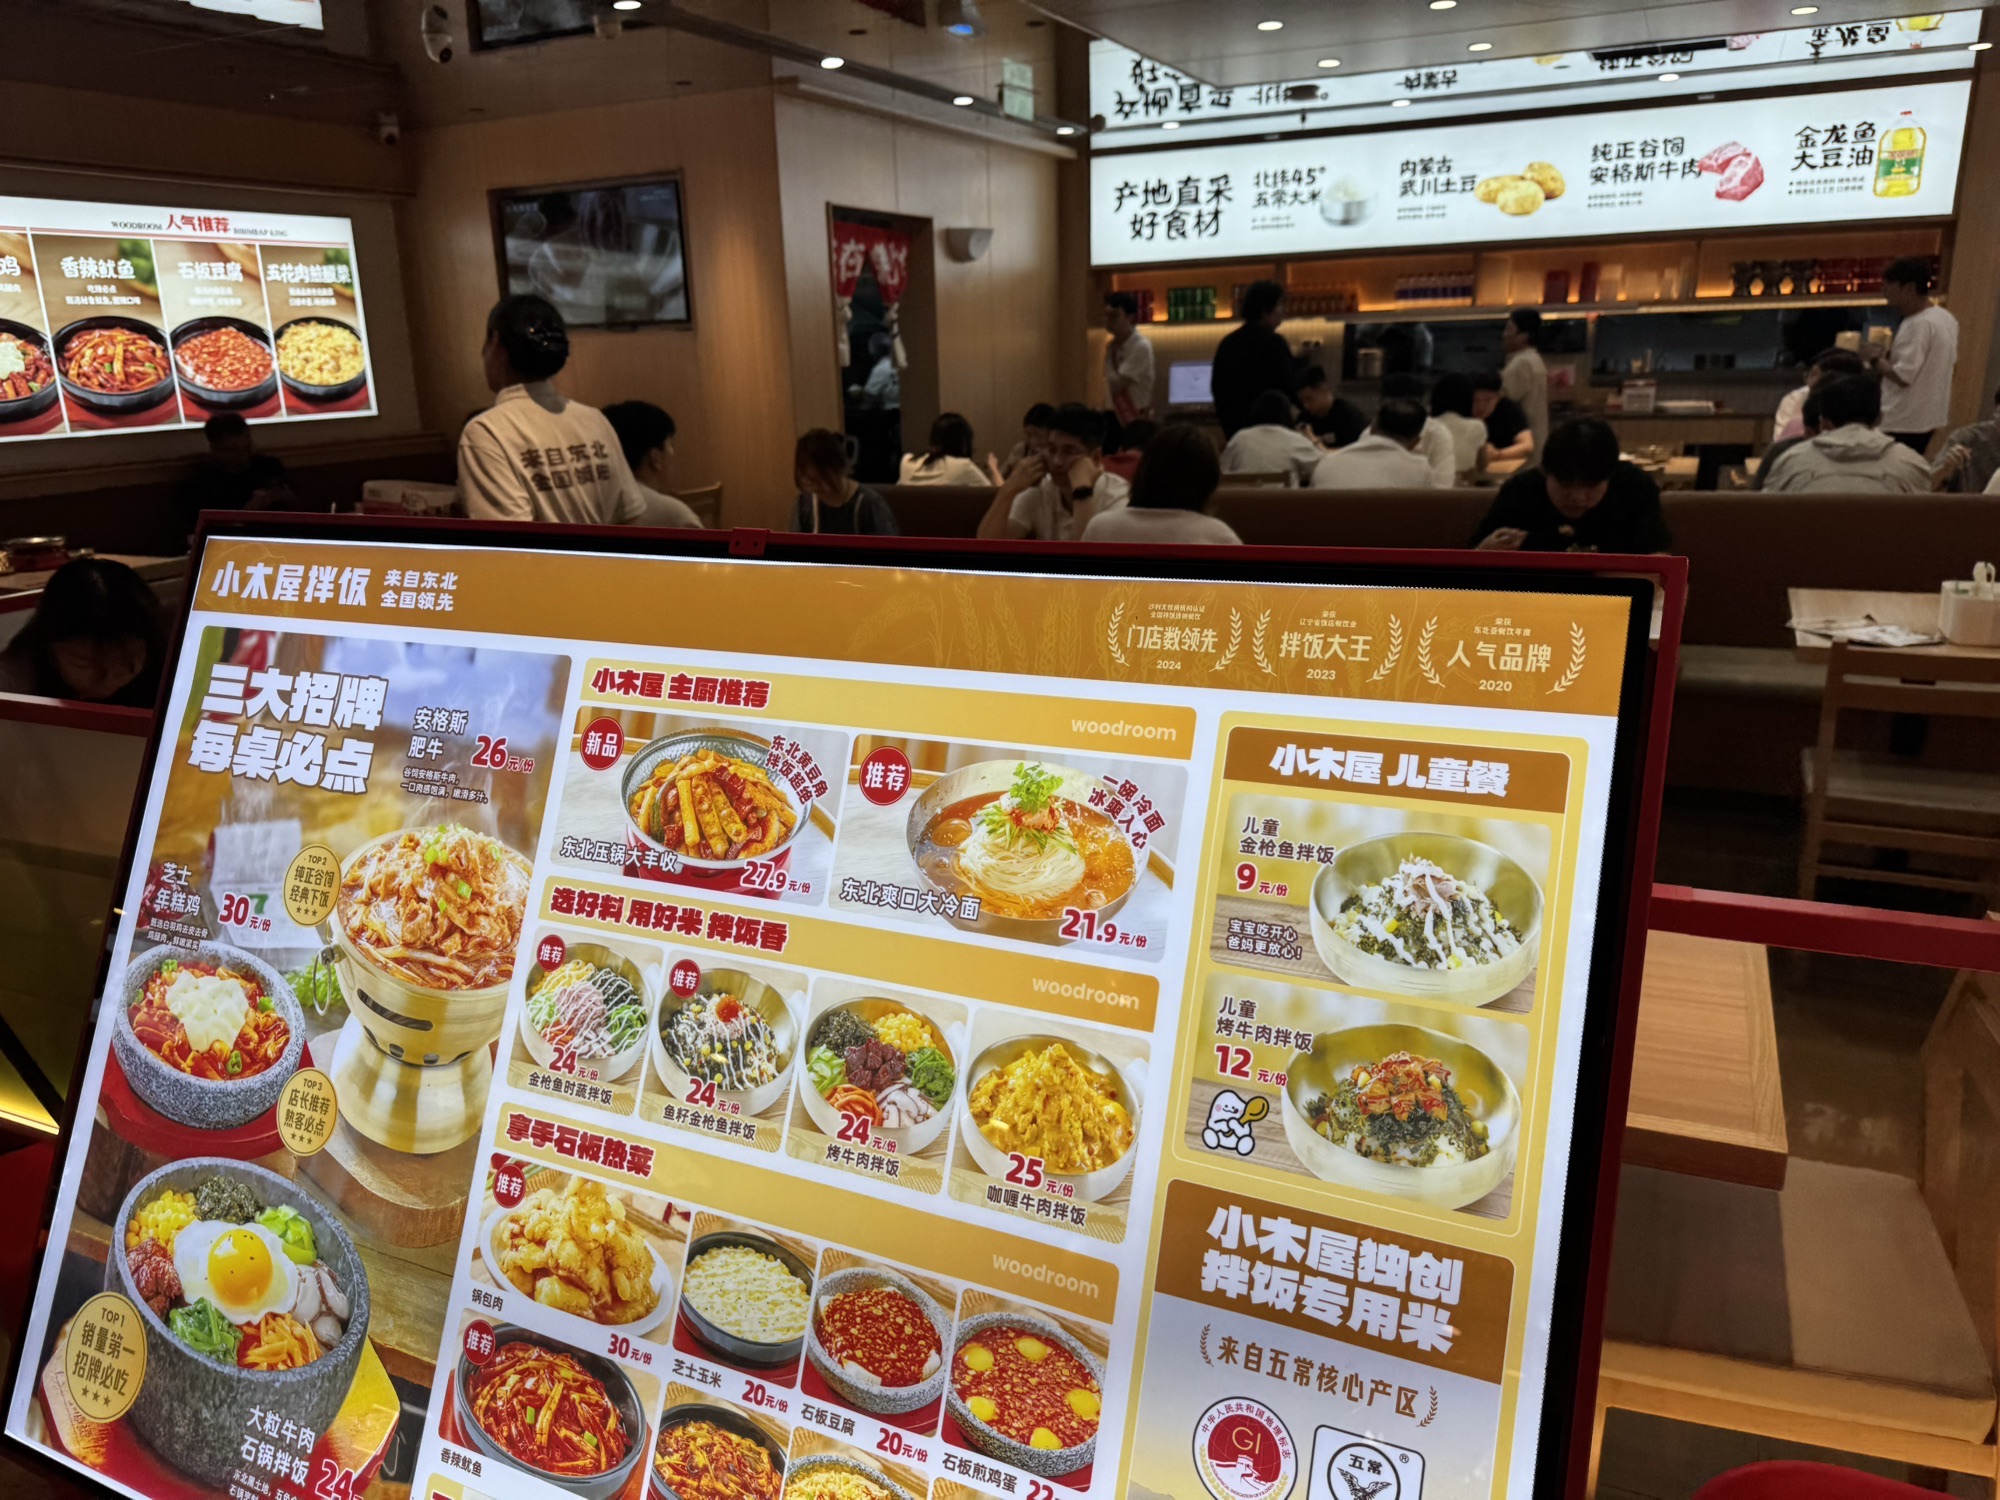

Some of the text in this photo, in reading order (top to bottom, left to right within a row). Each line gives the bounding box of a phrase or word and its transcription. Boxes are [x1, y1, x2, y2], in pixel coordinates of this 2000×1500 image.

[1794, 120, 1877, 150] 金龙鱼
[1591, 137, 1685, 163] 纯正谷饲
[1790, 145, 1874, 172] 大豆油
[1400, 155, 1453, 176] 内蒙古
[1589, 158, 1702, 186] 安格斯牛肉
[1114, 174, 1233, 213] 产地直采
[1252, 188, 1323, 209] 五常大米
[1399, 174, 1477, 198] 武川土豆
[167, 214, 230, 233] 人气推荐
[1130, 208, 1223, 241] 好食材
[60, 256, 136, 279] 香辣鱿鱼
[177, 261, 243, 282] 石板豆腐
[520, 440, 608, 469] 来自东北
[211, 561, 371, 606] 小木屋拌饭
[384, 569, 458, 590] 来自东北
[381, 591, 454, 611] 全国领先
[1127, 624, 1218, 653] 门店数领先
[1279, 631, 1372, 661] 拌饭大王
[1156, 660, 1181, 670] 2024
[1447, 640, 1552, 673] 人气品牌
[592, 667, 769, 708] 小木屋 主厨推荐
[1306, 669, 1336, 680] 2023
[1478, 680, 1512, 692] 2020
[201, 663, 389, 731] 三大招牌
[414, 708, 468, 734] 安格斯
[1071, 717, 1177, 741] woodroom
[188, 720, 375, 794] 每桌必点
[408, 736, 444, 760] 肥牛
[585, 731, 618, 758] 新品
[766, 751, 813, 805] 拌饭超绝
[771, 735, 828, 798] 东北黄豆角
[865, 761, 906, 792] 推荐
[1269, 743, 1510, 797] 小木屋 儿童餐
[1088, 787, 1147, 849] 冰爽入心
[1103, 775, 1165, 833] 一碗冷面
[1242, 816, 1279, 837] 儿童
[308, 855, 322, 864] TOP
[561, 836, 678, 873] 东北压锅大丰收
[1240, 836, 1335, 865] 金枪鱼拌饭
[161, 862, 192, 886] 芝士
[294, 865, 335, 888] 纯正谷饲
[155, 888, 200, 917] 年糕鸡
[289, 885, 330, 908] 经典下饭
[840, 878, 981, 921] 东北爽口大冷面
[550, 886, 788, 952] 选好料 用好米 拌饭香
[1229, 919, 1298, 941] 宝宝吃开心
[540, 944, 563, 964] 推荐
[673, 969, 697, 990] 推荐
[1032, 976, 1140, 1010] woodroom
[1219, 996, 1257, 1020] 儿童
[1215, 1017, 1313, 1053] 烤牛肉拌饭
[304, 1078, 317, 1089] TOP
[528, 1072, 613, 1105] 金枪鱼时蔬拌饭
[288, 1088, 331, 1115] 店长推荐
[284, 1108, 325, 1137] 熟客必点
[663, 1104, 756, 1141] 鱼籽金枪鱼拌饭
[506, 1112, 655, 1177] 拿手石板热菜
[825, 1144, 900, 1179] 烤牛肉拌饭
[496, 1173, 523, 1198] 推荐
[986, 1183, 1086, 1227] 咖喱牛肉拌饭
[1206, 1205, 1464, 1305] 小木屋独创
[992, 1253, 1100, 1299] woodroom
[471, 1288, 504, 1312] 锅包肉
[1201, 1249, 1455, 1354] 拌饭专用米
[102, 1307, 119, 1324] TOP
[82, 1320, 135, 1359] 销量第一
[466, 1329, 493, 1355] 推荐
[72, 1350, 129, 1396] 招牌必吃
[671, 1357, 722, 1389] 芝士玉米
[1217, 1335, 1419, 1418] 来自五常核心产区
[247, 1405, 316, 1454] 大粒牛肉
[800, 1403, 856, 1436] 石板豆腐
[1201, 1402, 1291, 1460] 中华人民共和国地理标志
[1232, 1427, 1261, 1454] GI
[241, 1434, 309, 1487] 石锅拌饭
[440, 1447, 482, 1479] 香辣鱿鱼
[942, 1452, 1018, 1494] 石板煎鸡蛋
[1349, 1453, 1383, 1475] 五常
